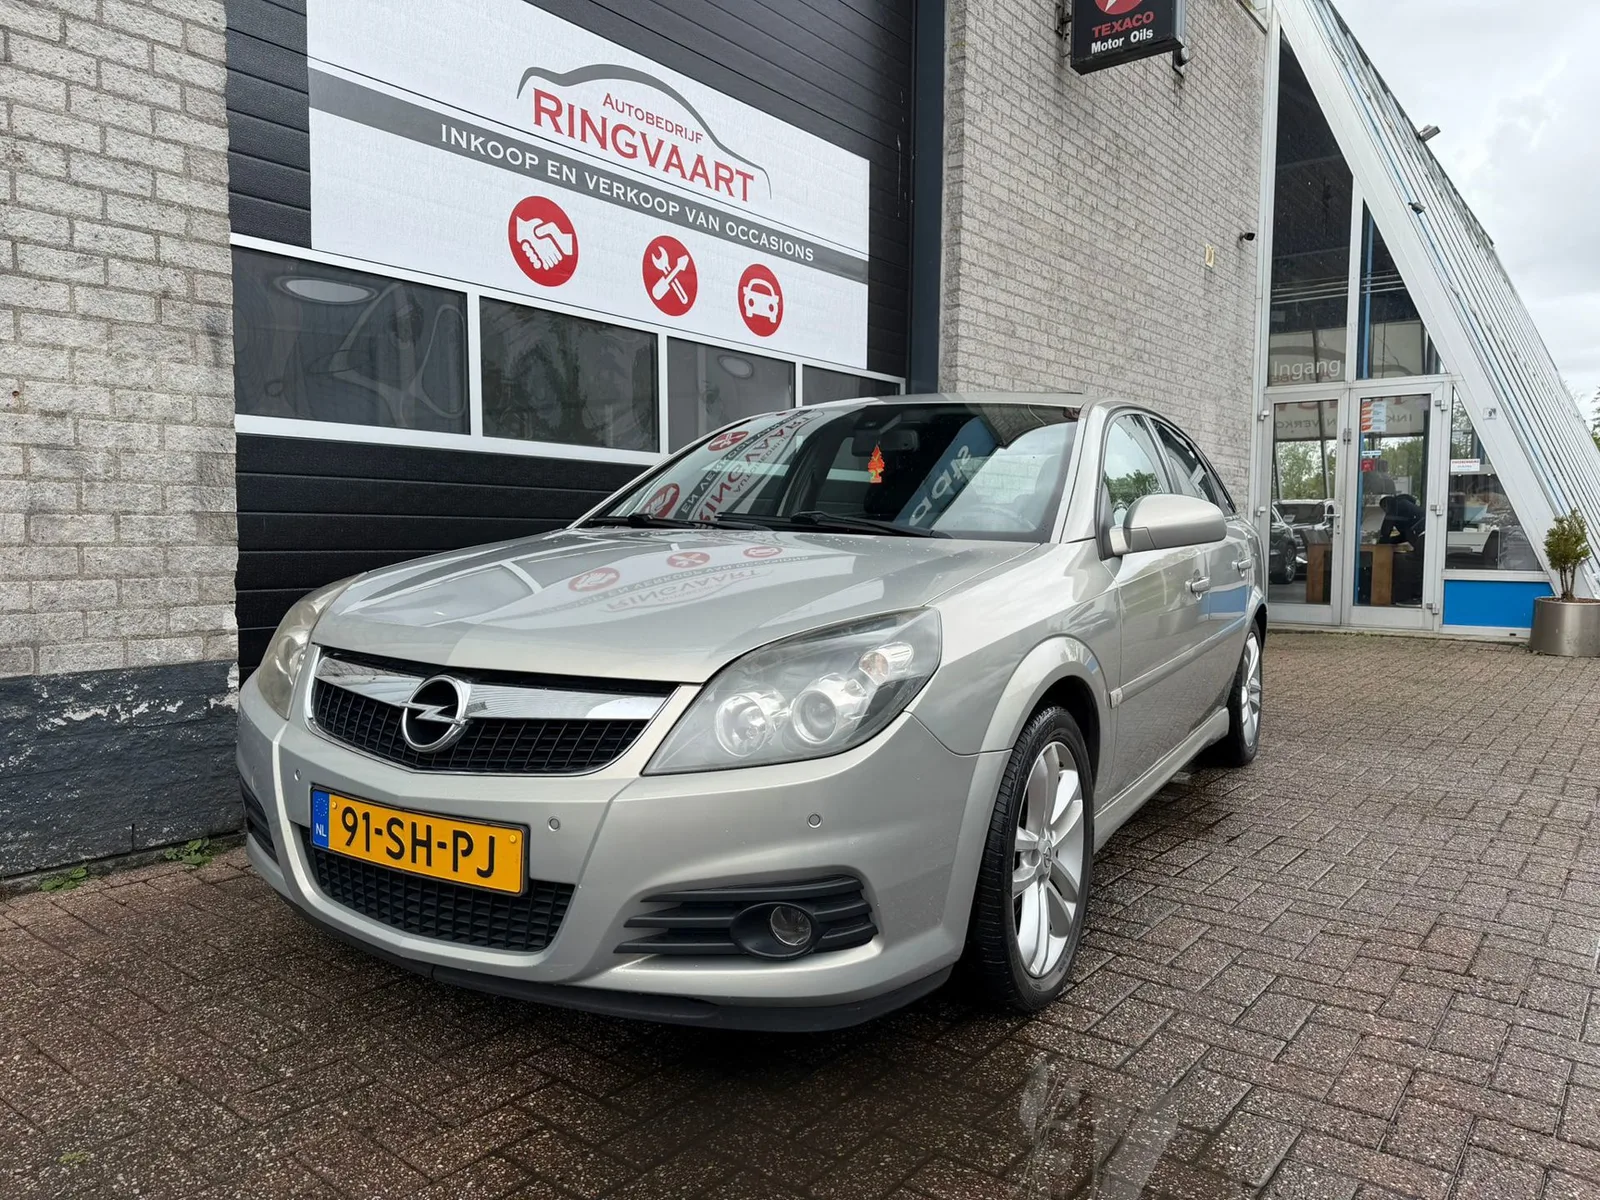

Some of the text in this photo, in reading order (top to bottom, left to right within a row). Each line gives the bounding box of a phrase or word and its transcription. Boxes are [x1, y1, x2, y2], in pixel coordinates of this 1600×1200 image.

[1091, 27, 1154, 54] Motor Oils
[1092, 11, 1154, 38] TEXACO
[602, 92, 703, 144] AUTOBEDRIJF
[533, 88, 754, 202] RINGVAART
[441, 124, 814, 262] INKOOP EN VERKOOP VAN OCCASIONS
[1274, 360, 1340, 380] Ingang
[315, 822, 327, 837] NL
[341, 806, 495, 878] 91-SH-PJ
